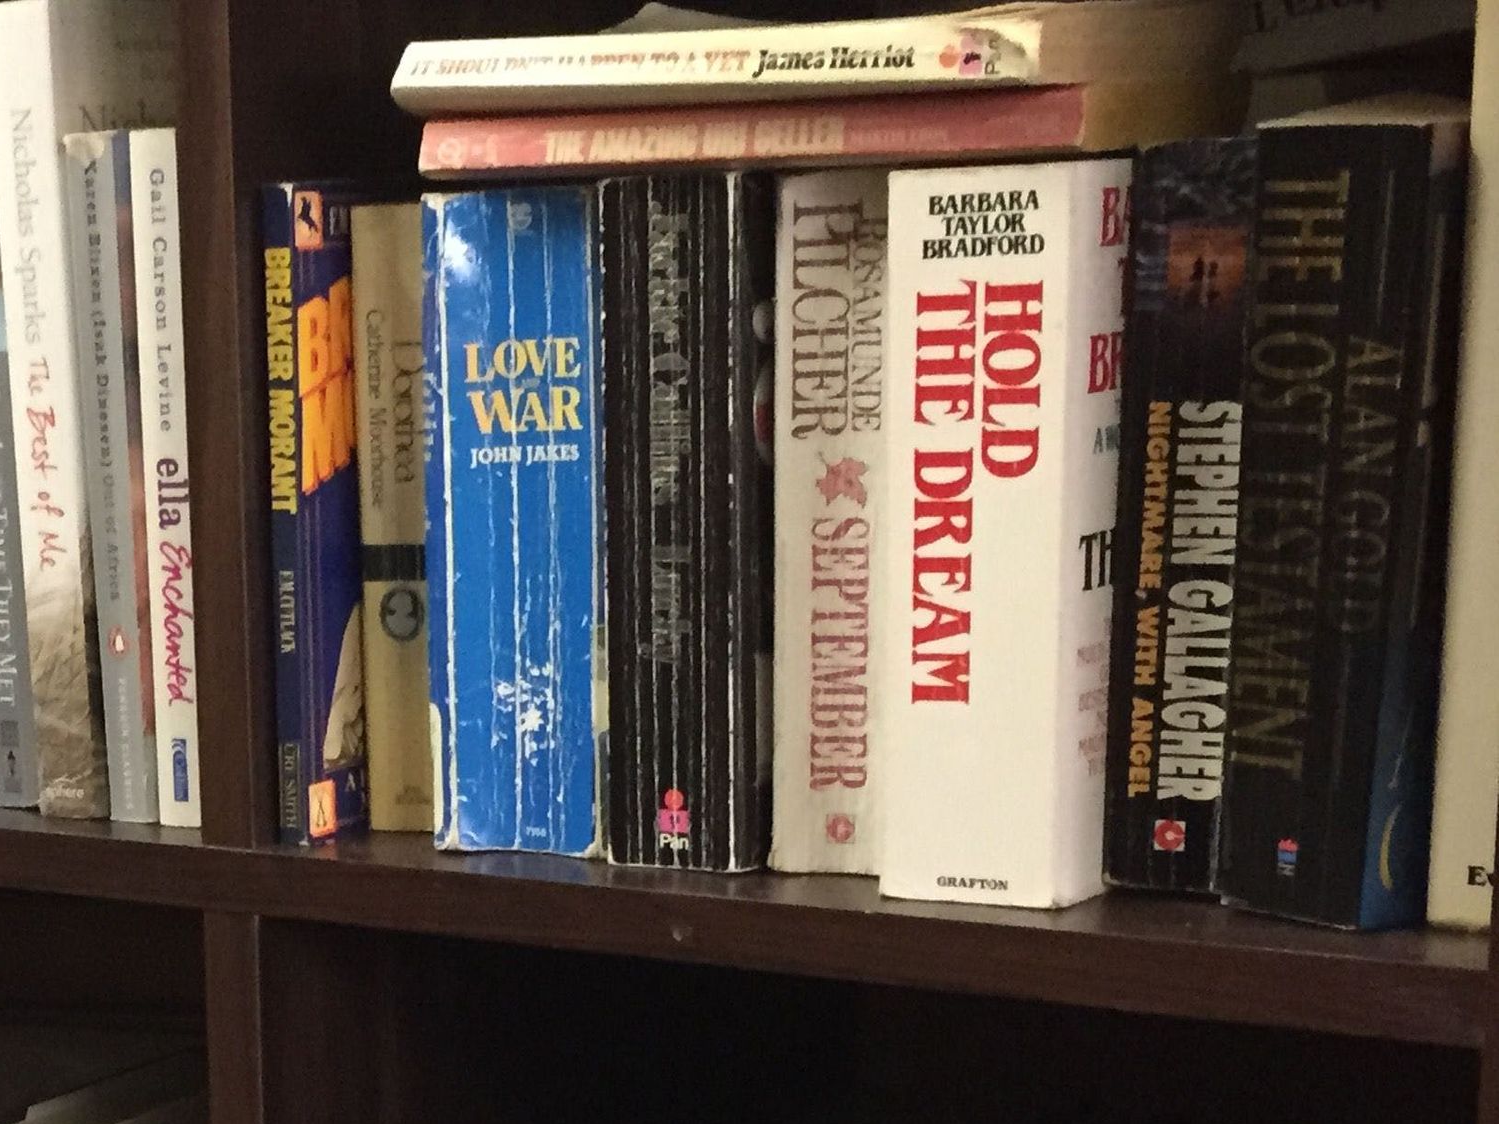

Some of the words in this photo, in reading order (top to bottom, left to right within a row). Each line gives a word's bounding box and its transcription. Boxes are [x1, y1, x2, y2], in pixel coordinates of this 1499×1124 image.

[752, 48, 826, 78] James
[827, 44, 916, 70] Herriot
[9, 108, 39, 238] Nicholas
[84, 160, 98, 226] Karen
[149, 168, 167, 225] Gail
[928, 189, 1040, 216] BARBARA
[921, 233, 1045, 260] BRADFORD
[941, 213, 1026, 237] TAYLOR
[1256, 167, 1351, 283] THE
[14, 247, 47, 345] Sparks
[153, 236, 169, 330] Carson
[264, 247, 294, 381] BREAKER
[791, 202, 863, 440] PILCHER
[851, 217, 888, 432] ROSAMUNDE
[27, 357, 51, 396] The
[156, 343, 172, 433] Levine
[463, 334, 582, 384] LOVE
[913, 278, 977, 427] THE
[981, 279, 1043, 479] HOLD
[1247, 302, 1340, 444] LOST
[26, 406, 58, 475] Best
[269, 389, 297, 515] MORANT
[466, 384, 584, 435] WAR
[1341, 335, 1405, 476] ALAN
[156, 458, 190, 529] ella
[470, 444, 523, 469] JOHN
[525, 443, 581, 467] JAKES
[1170, 399, 1243, 566] STEPHEN
[30, 490, 65, 520] of
[37, 531, 68, 572] Me
[911, 447, 974, 705] DREAM
[1229, 463, 1327, 781] TESTAMENT
[159, 540, 195, 707] Enchanted
[809, 517, 870, 791] SEPTEMBER
[1132, 605, 1161, 687] WITH
[1155, 578, 1235, 801] GALLAGHER
[1127, 697, 1154, 798] ANGEL
[659, 833, 689, 850] Pan
[936, 875, 1009, 892] GRAFTON
